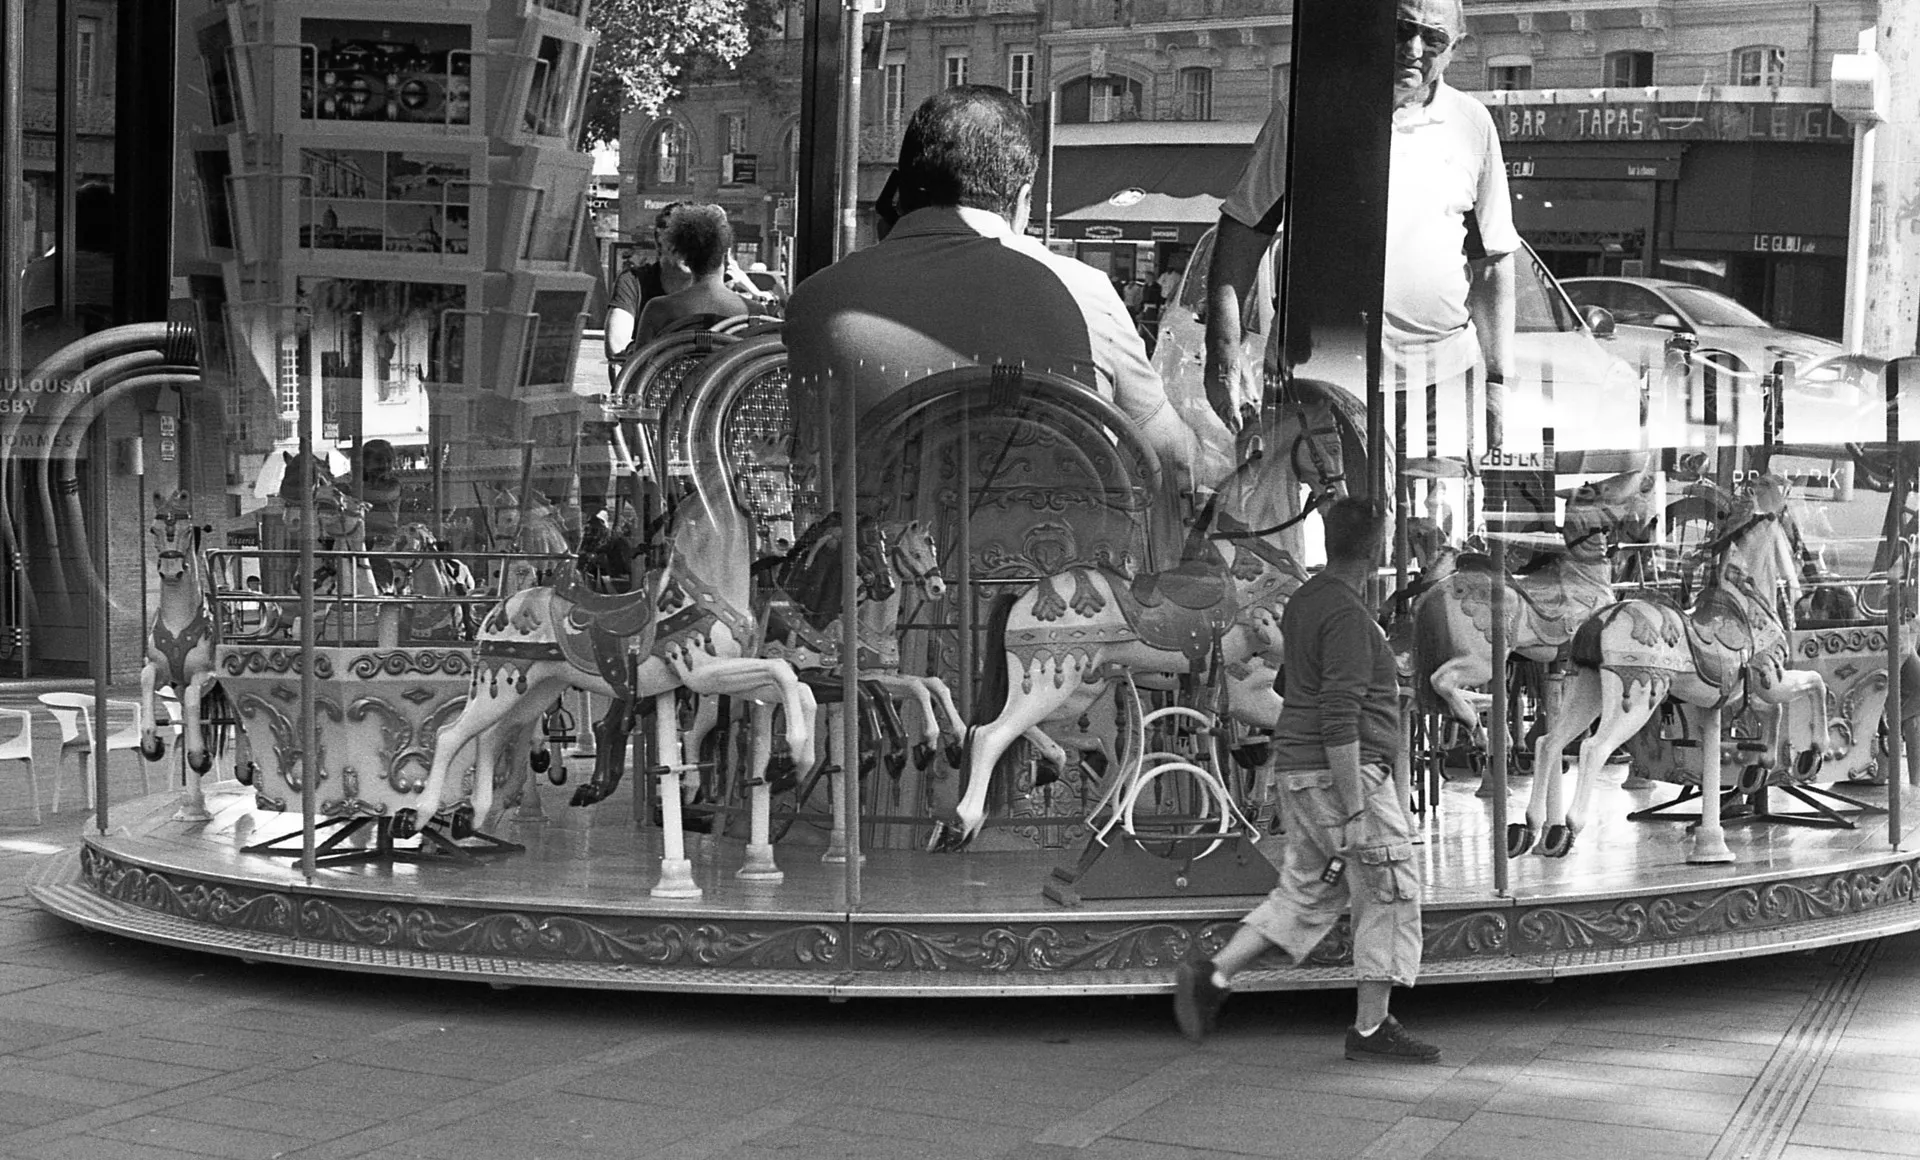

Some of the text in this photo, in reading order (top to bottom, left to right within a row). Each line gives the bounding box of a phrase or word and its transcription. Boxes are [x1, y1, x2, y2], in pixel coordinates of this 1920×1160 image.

[1509, 107, 1644, 136] BAR TAPAS
[1749, 106, 1855, 139] LE GL
[1753, 234, 1769, 251] LE
[1771, 235, 1802, 253] GLOU
[0, 377, 92, 394] ULOUSAI
[0, 399, 37, 414] GBY
[0, 434, 74, 448] OMMES
